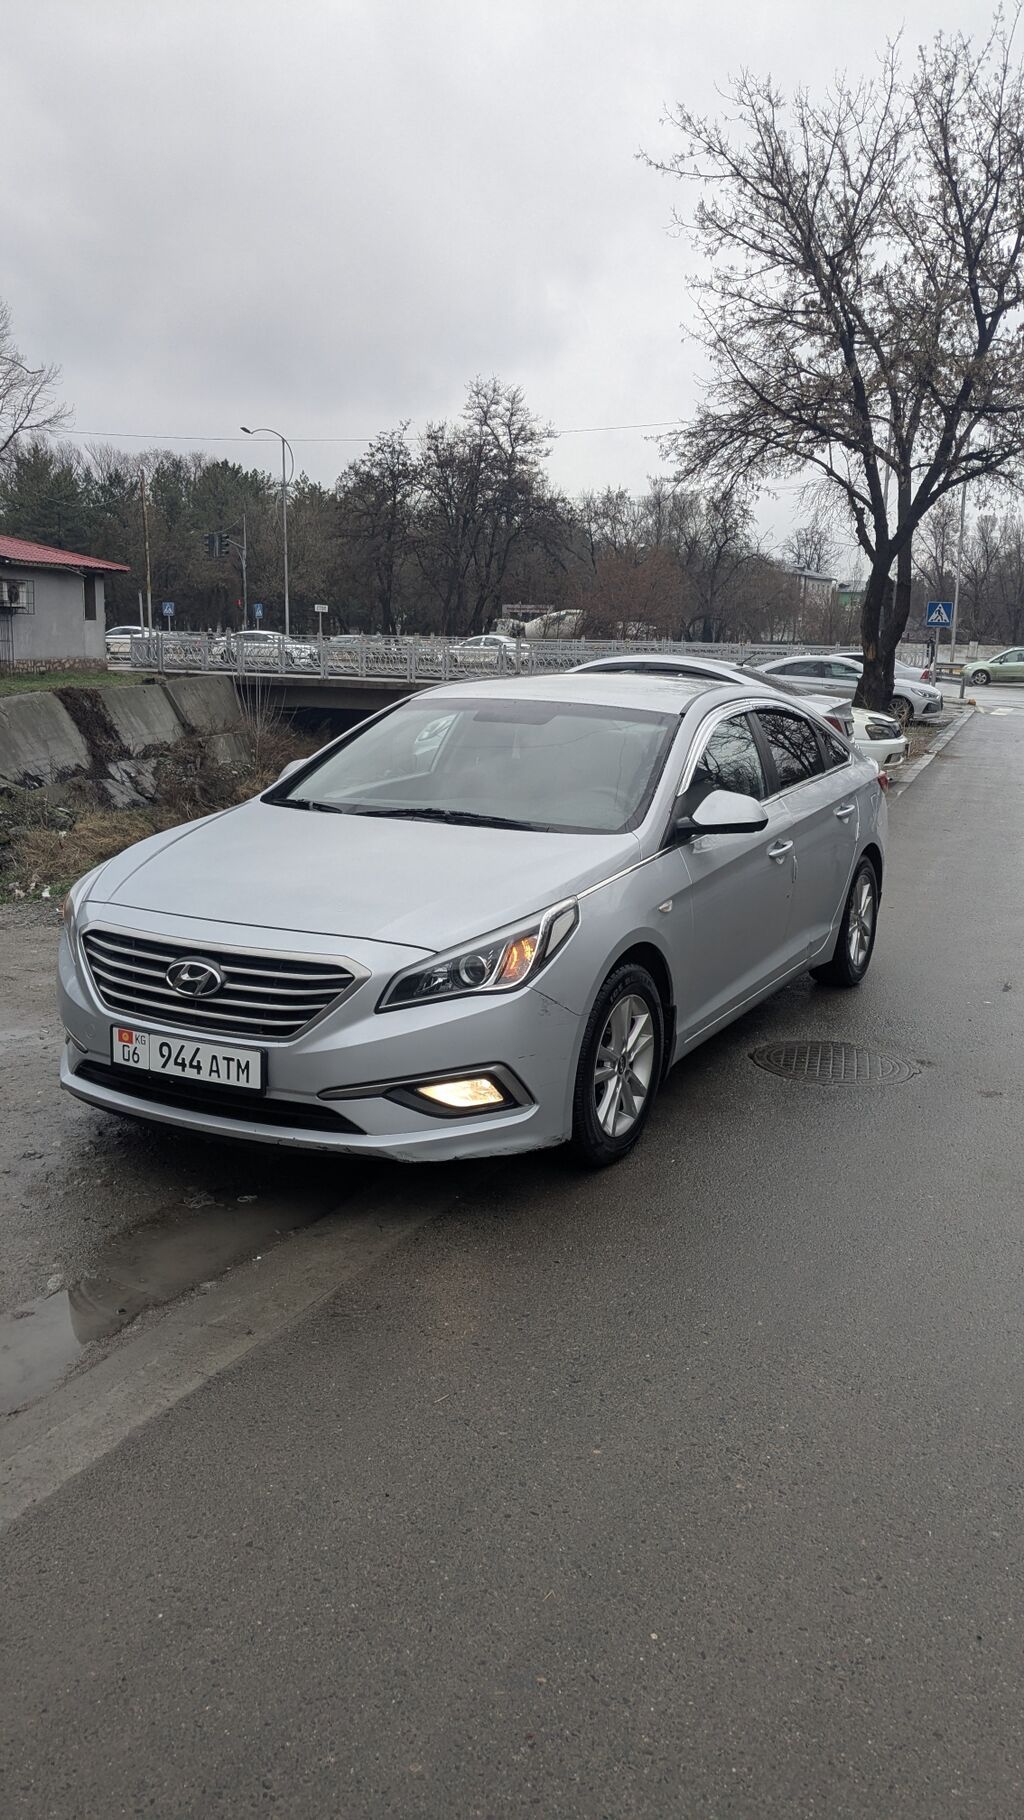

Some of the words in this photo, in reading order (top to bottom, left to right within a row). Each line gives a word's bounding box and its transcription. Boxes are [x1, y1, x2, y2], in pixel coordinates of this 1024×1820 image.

[135, 1034, 146, 1045] KG
[122, 1044, 140, 1064] 06
[158, 1041, 202, 1075] 944
[208, 1054, 250, 1084] ATM
